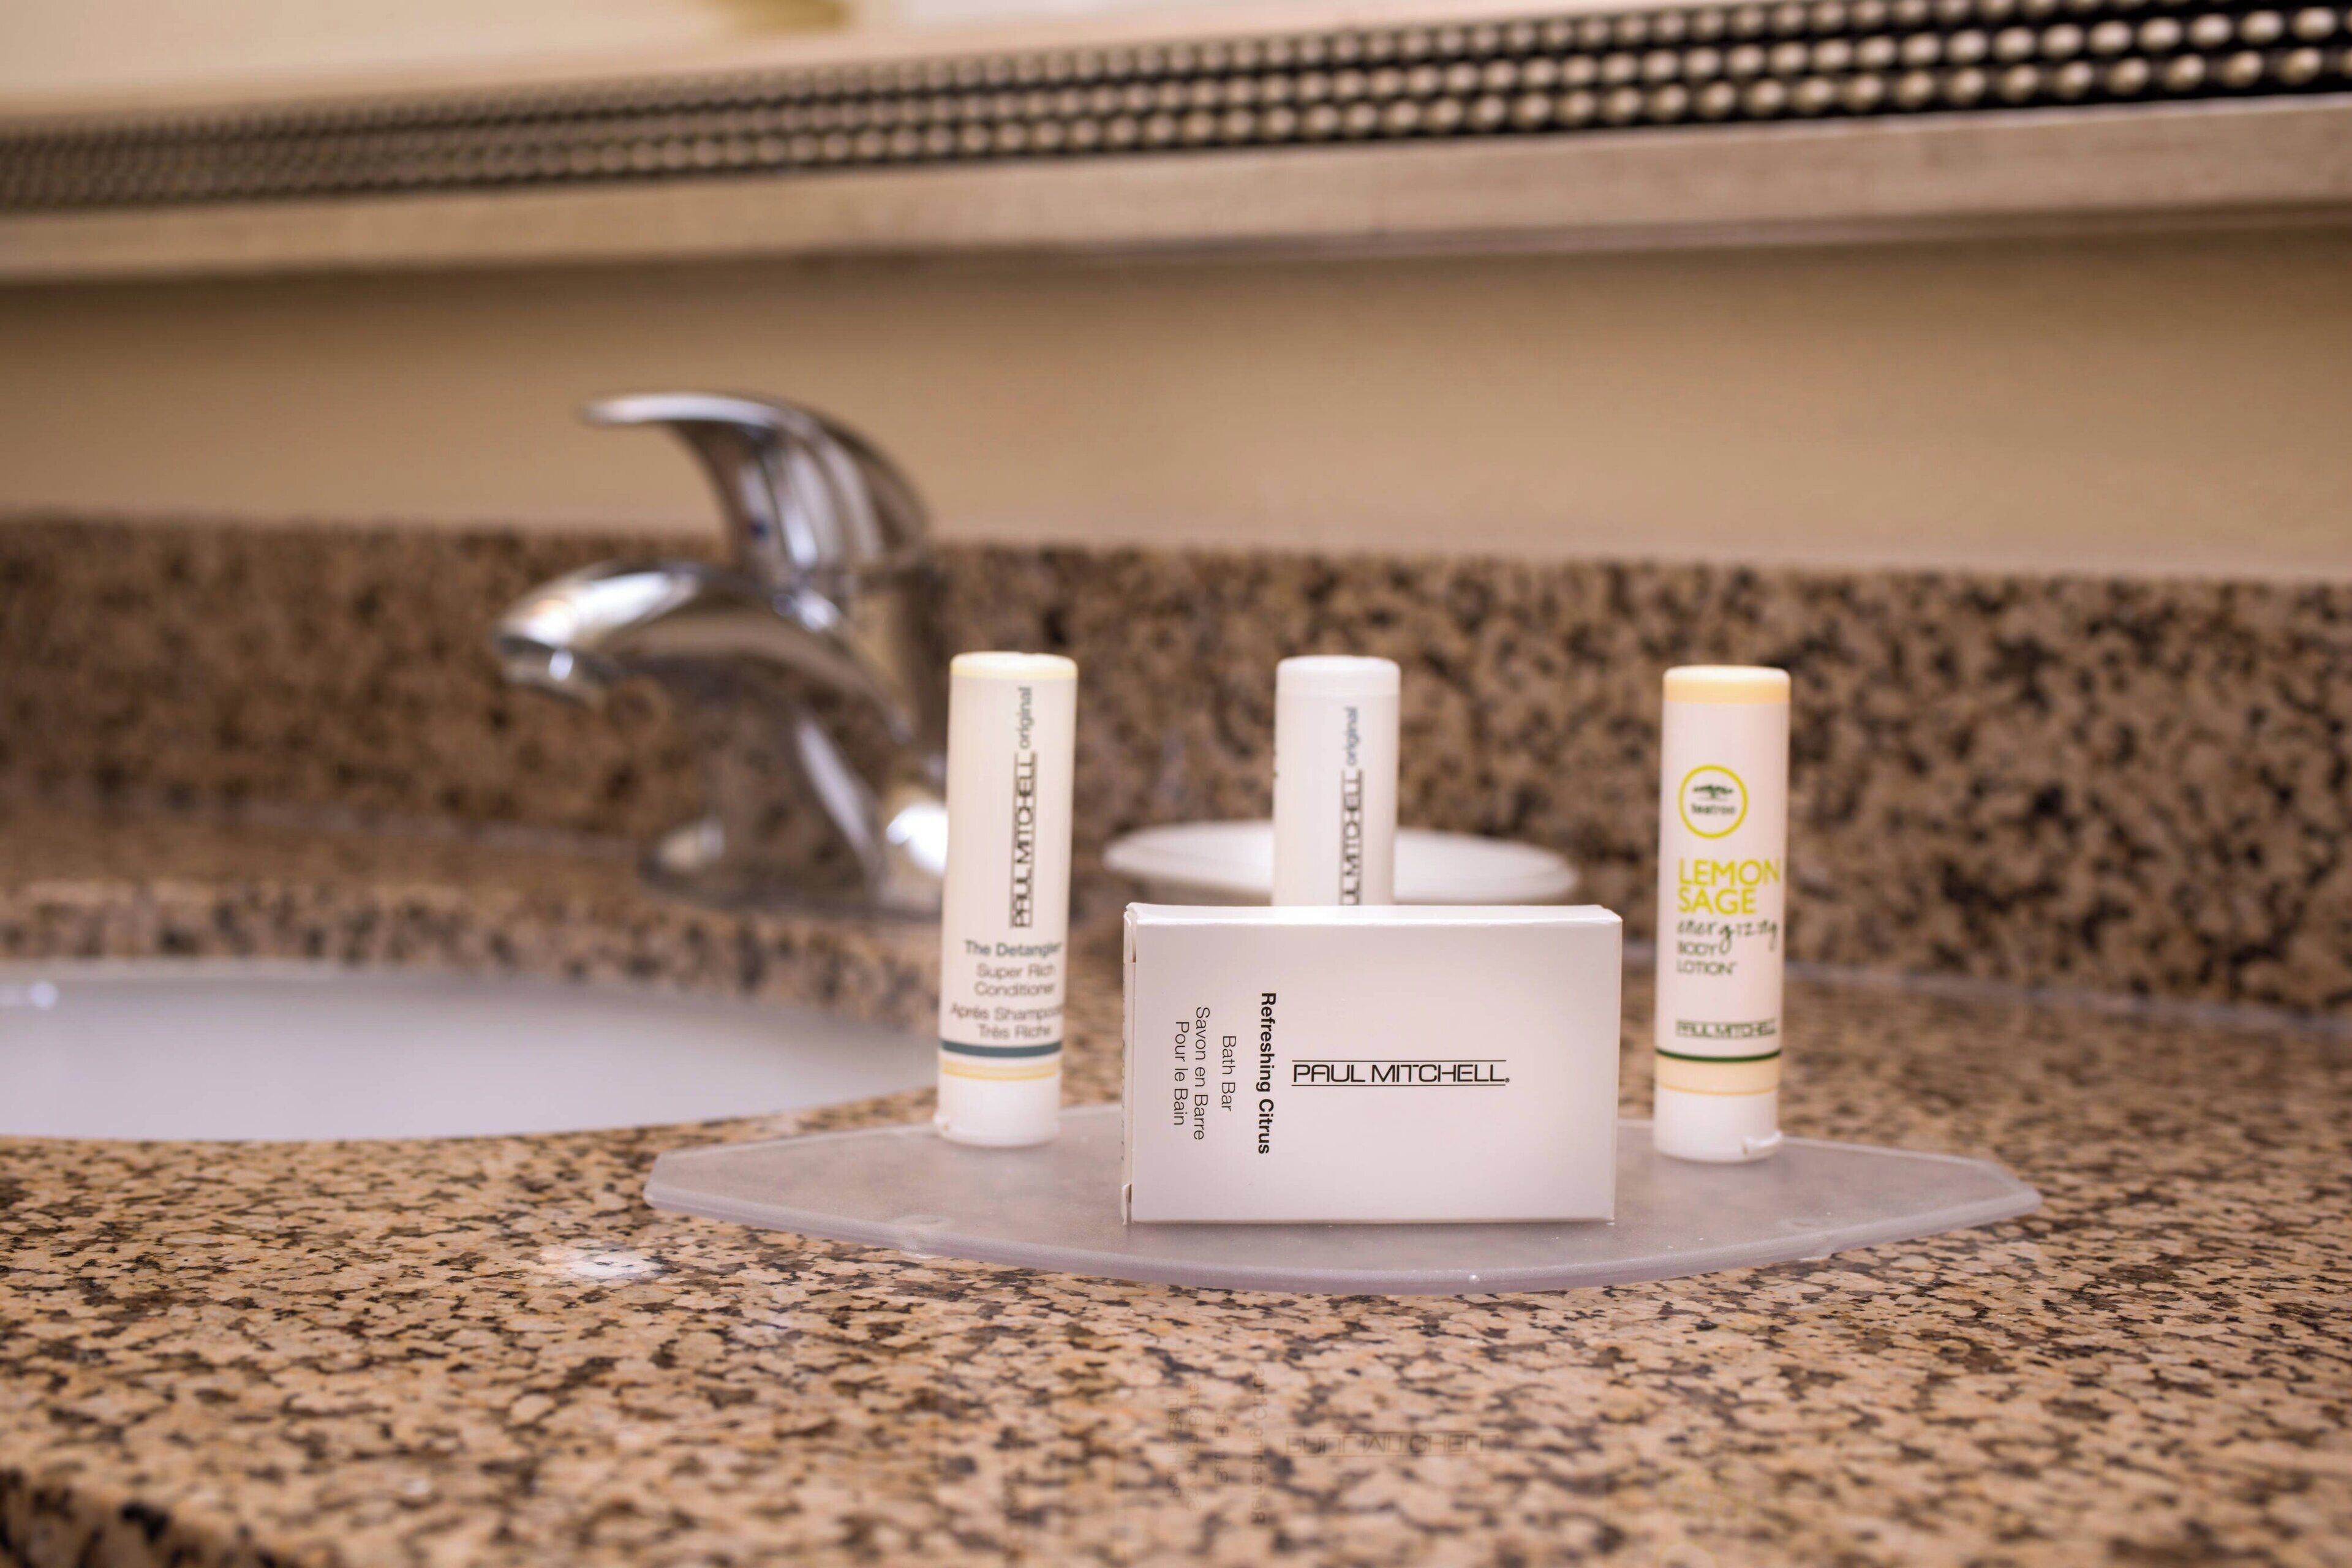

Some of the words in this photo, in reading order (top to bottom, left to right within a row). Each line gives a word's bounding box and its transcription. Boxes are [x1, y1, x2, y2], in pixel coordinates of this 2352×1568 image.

[1016, 687, 1034, 749] original
[1343, 707, 1360, 766] original
[1015, 753, 1036, 864] MITCHELL
[1678, 858, 1780, 886] LEMON
[1012, 868, 1033, 928] PAUL
[1678, 888, 1757, 915] SAGE
[965, 940, 990, 956] The
[1676, 941, 1717, 956] BODY
[977, 962, 1022, 980] Super
[1028, 963, 1055, 978] Rich
[1174, 1021, 1189, 1062] Pour
[1195, 1006, 1210, 1060] Savon
[1256, 992, 1276, 1092] Refreshing
[1222, 1035, 1237, 1075] Bath
[1293, 1064, 1366, 1083] PAUL
[1174, 1068, 1189, 1082] le
[1194, 1066, 1205, 1087] en
[1173, 1088, 1188, 1126] Bain
[1221, 1082, 1235, 1112] Bar
[1193, 1094, 1208, 1140] Barre
[1258, 1098, 1274, 1155] Citrus
